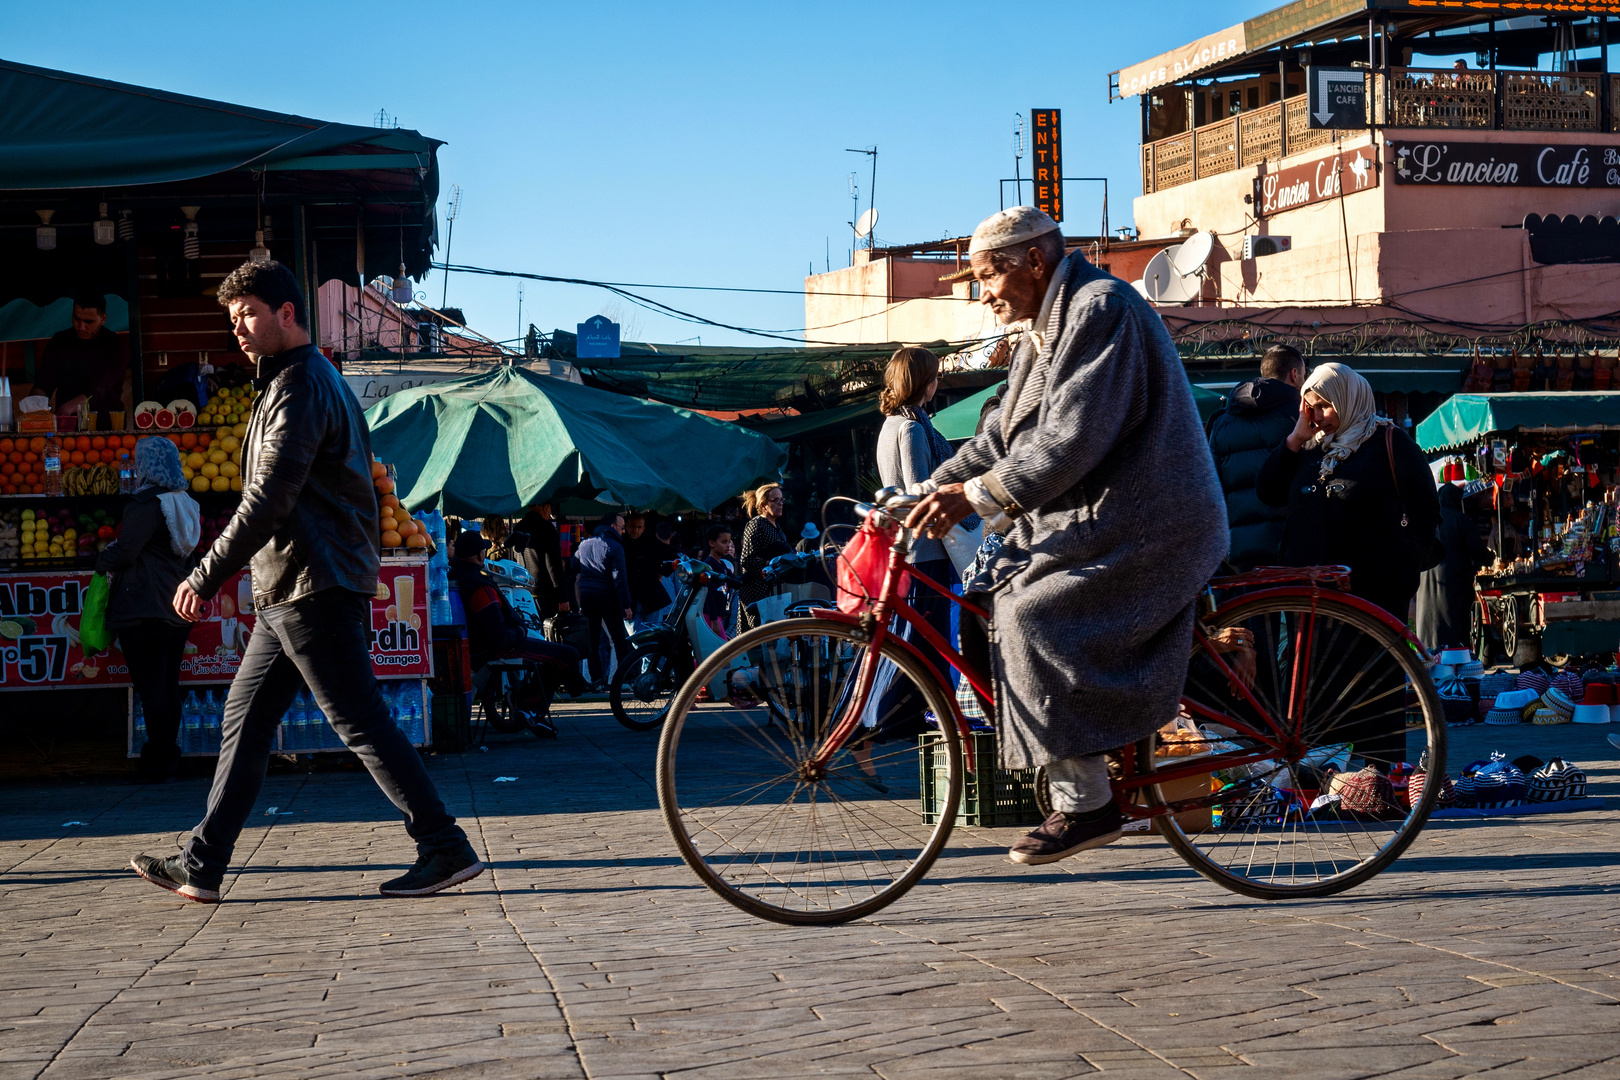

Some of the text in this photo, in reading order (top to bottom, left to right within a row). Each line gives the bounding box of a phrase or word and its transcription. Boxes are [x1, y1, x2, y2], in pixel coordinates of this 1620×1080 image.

[1130, 38, 1237, 91] CAFE GLACIER
[1328, 84, 1364, 94] L'ANCIEN
[1336, 95, 1357, 105] CAFE
[1036, 113, 1050, 216] ENTREE
[1412, 144, 1591, 185] L'ancien Café
[1262, 156, 1341, 213] L'ancien Café
[361, 380, 392, 399] La
[0, 580, 86, 617] Abd
[107, 665, 129, 675] 10 dh
[197, 664, 210, 675] Jus
[210, 663, 220, 674] de
